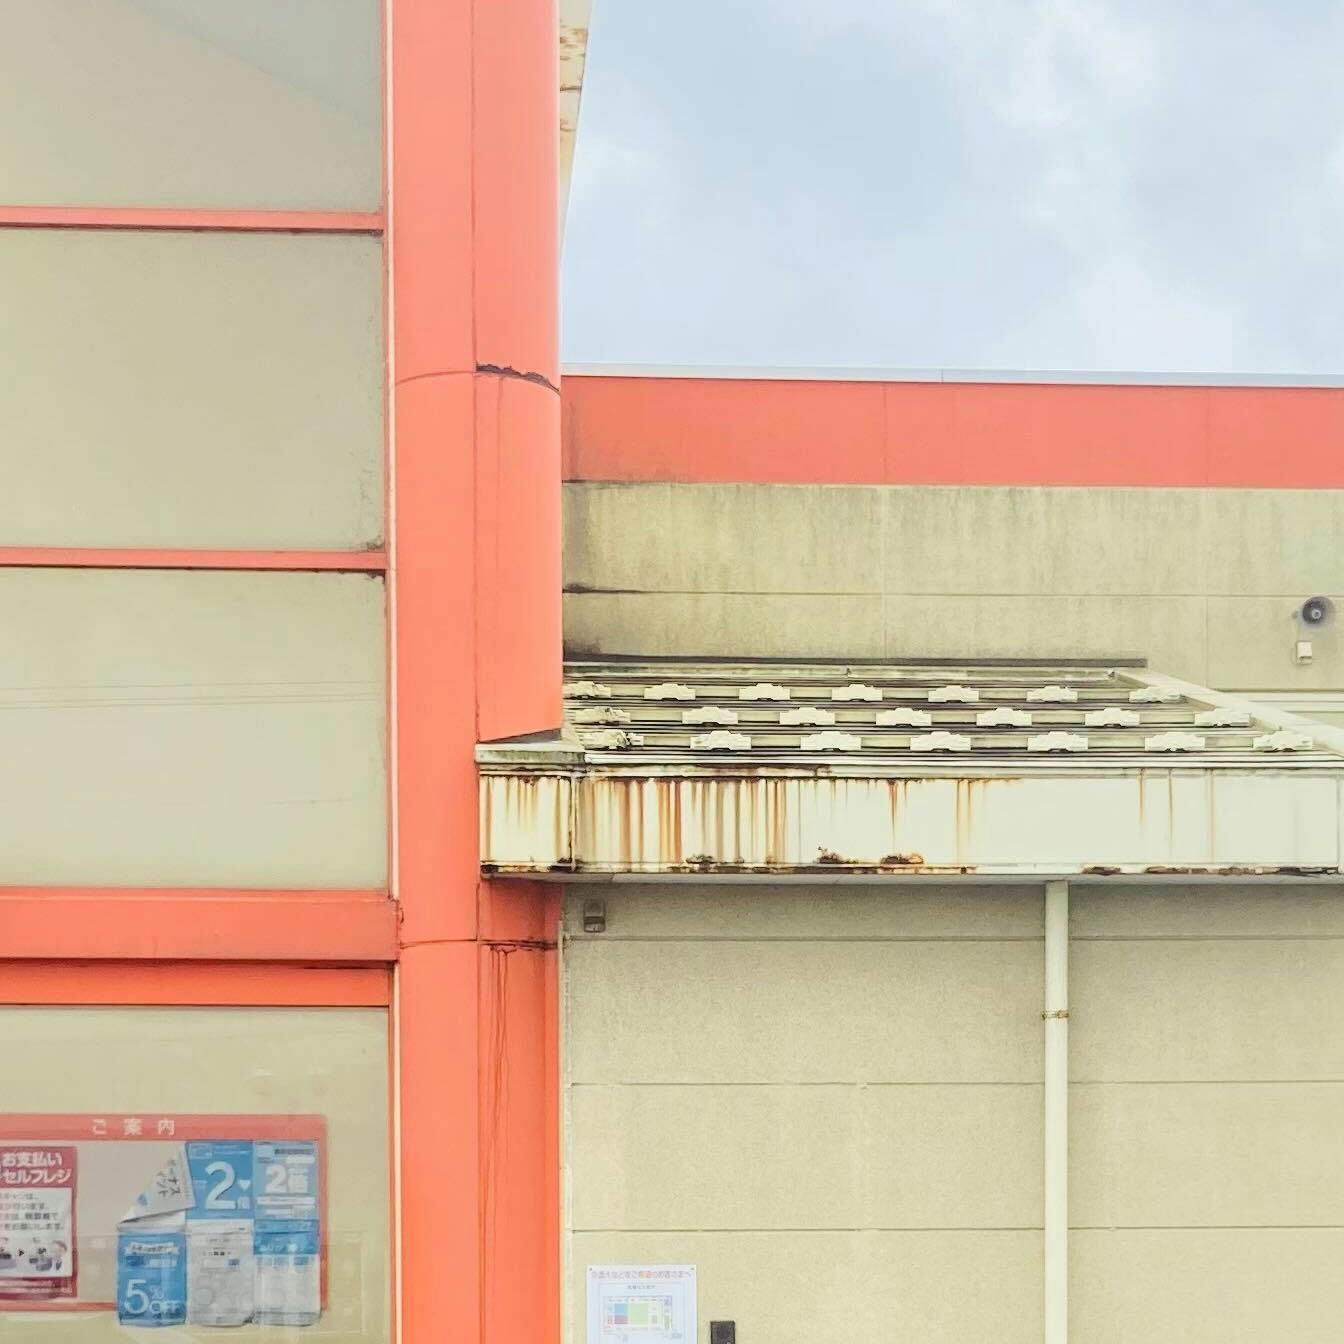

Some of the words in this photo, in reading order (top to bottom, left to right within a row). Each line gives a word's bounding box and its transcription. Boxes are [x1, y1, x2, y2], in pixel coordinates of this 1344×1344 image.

[91, 1117, 175, 1136] ご案内
[2, 1152, 63, 1168] お支払い
[2, 1168, 72, 1185] セルフレジ
